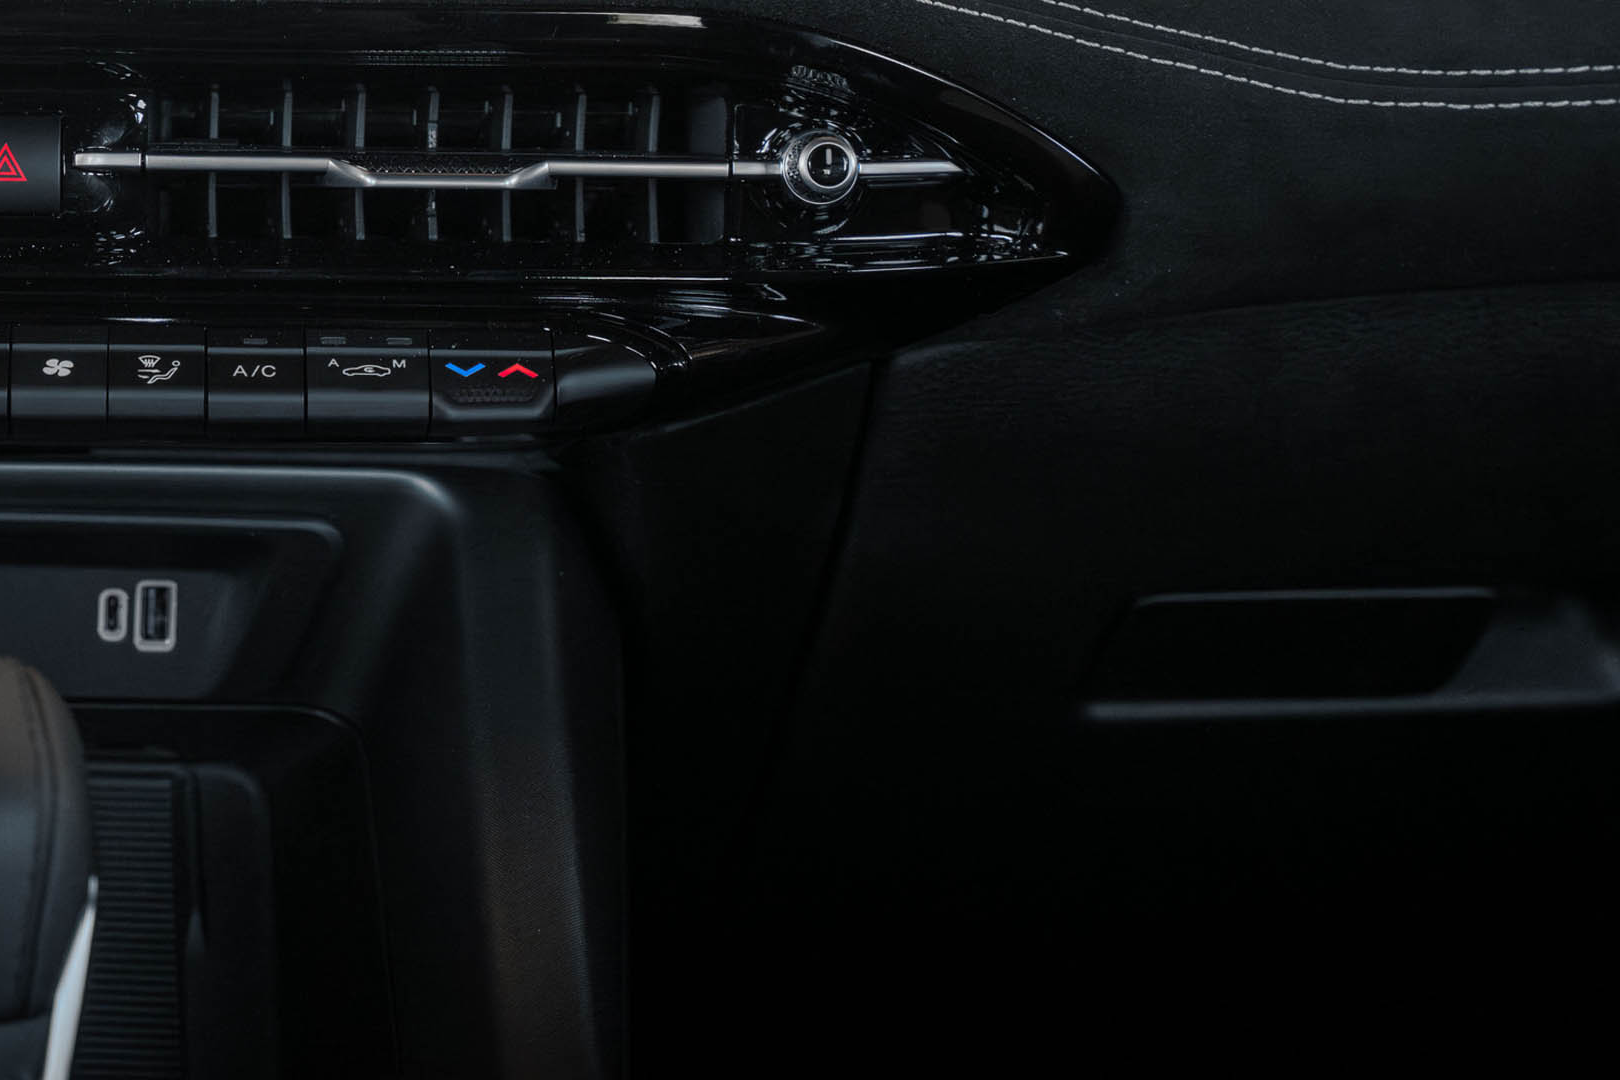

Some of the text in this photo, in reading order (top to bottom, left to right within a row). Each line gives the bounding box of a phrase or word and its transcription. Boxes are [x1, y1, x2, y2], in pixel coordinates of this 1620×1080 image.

[327, 358, 340, 368] A
[393, 359, 407, 369] M
[232, 364, 277, 379] A/C
